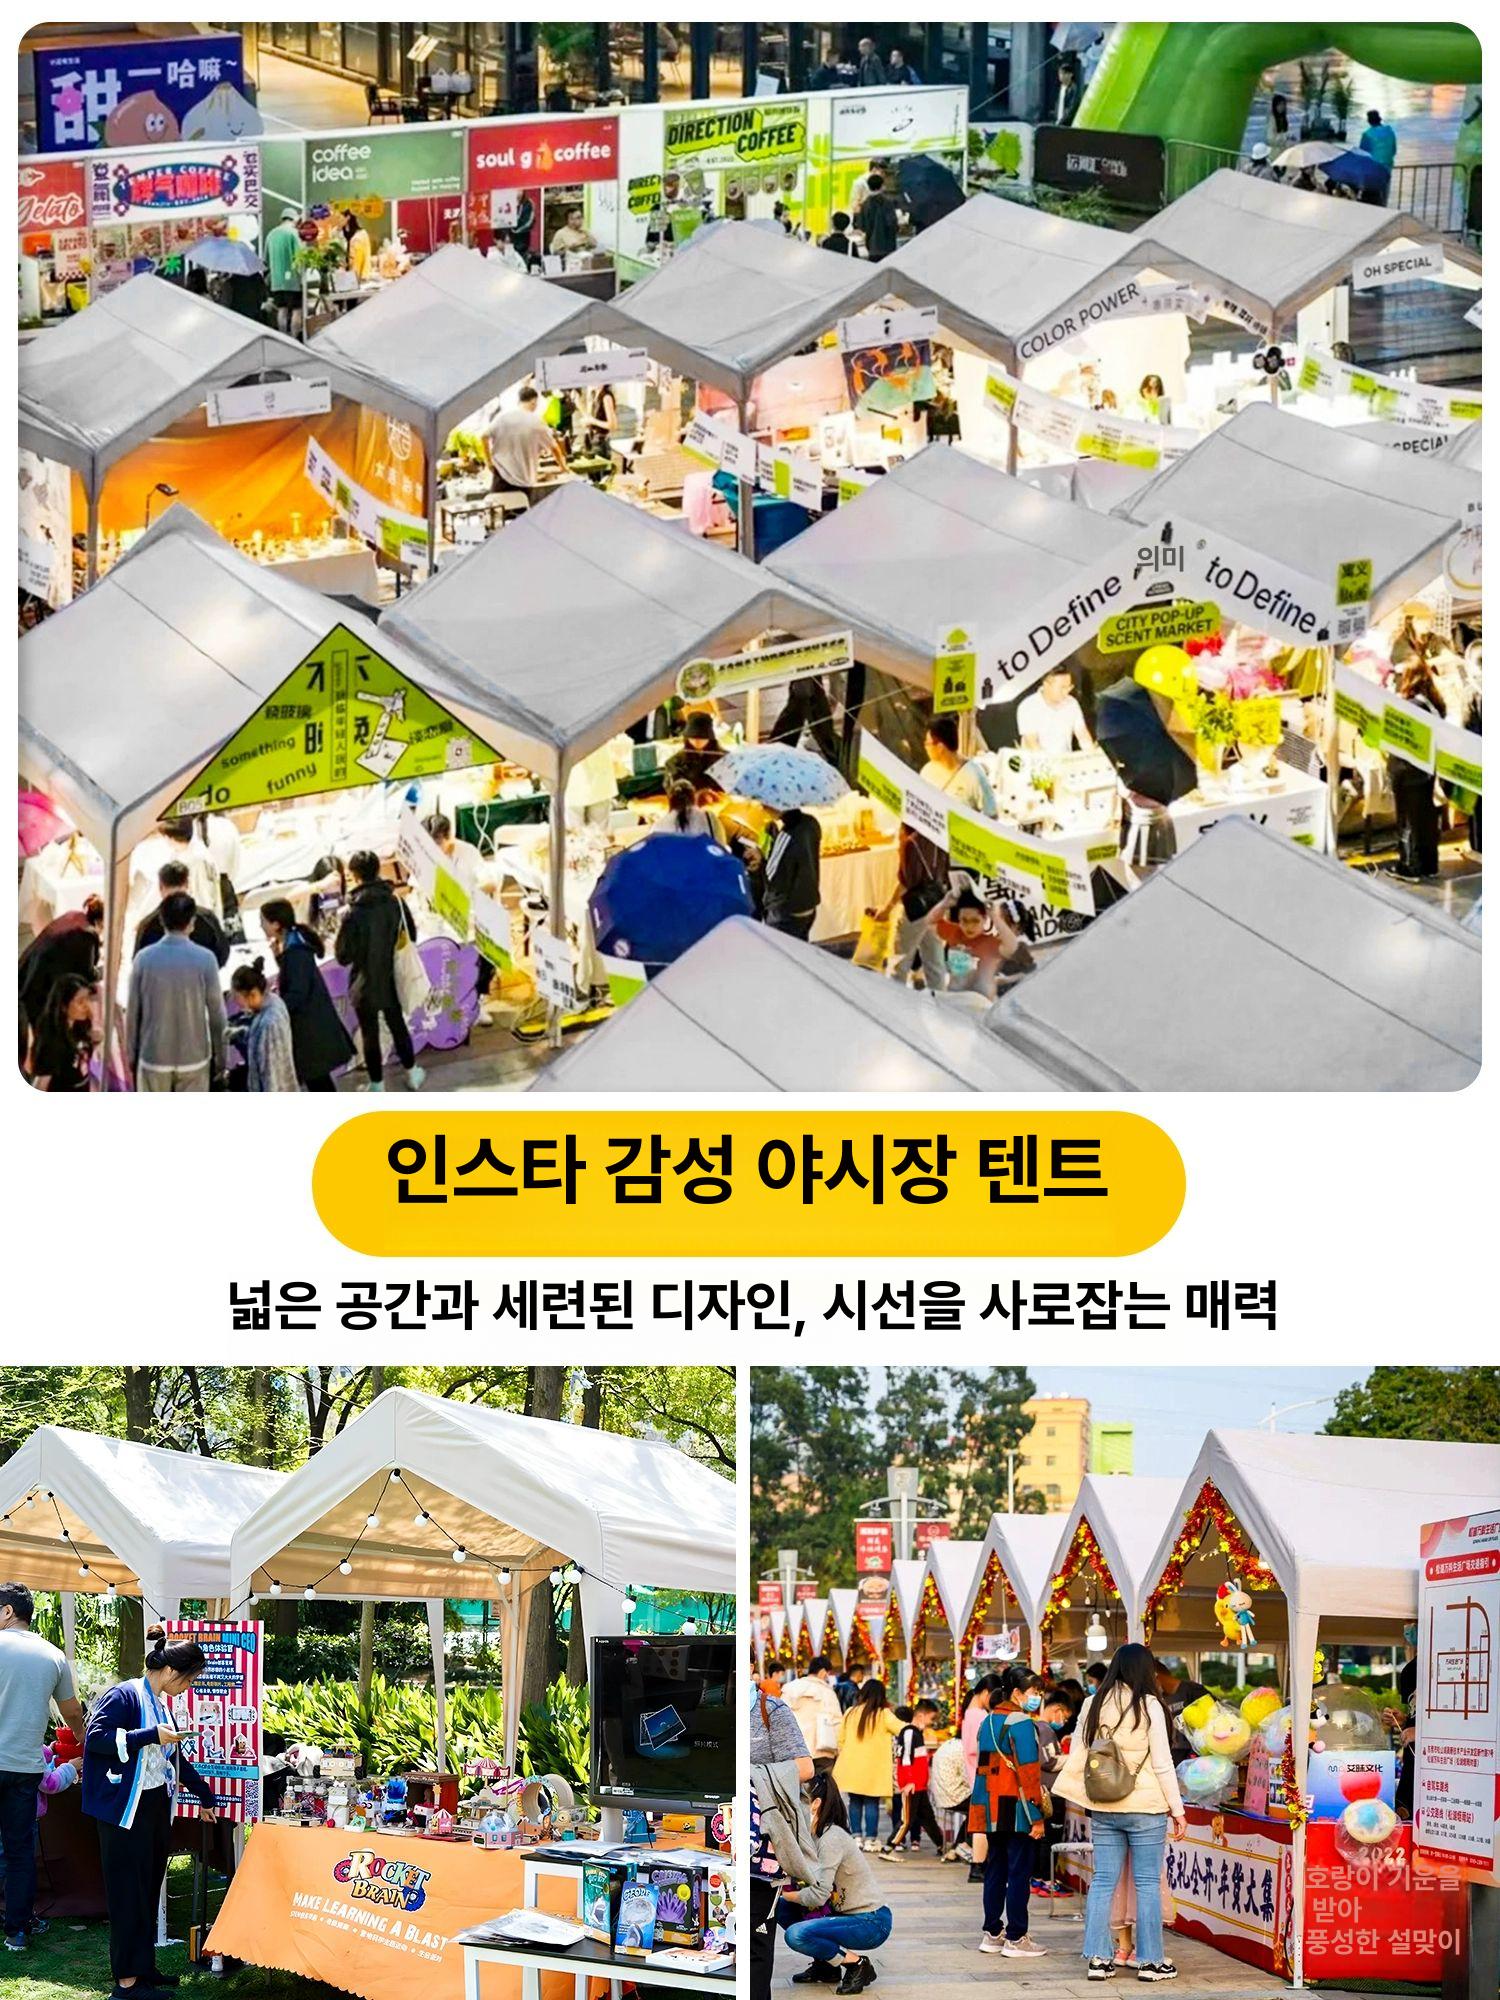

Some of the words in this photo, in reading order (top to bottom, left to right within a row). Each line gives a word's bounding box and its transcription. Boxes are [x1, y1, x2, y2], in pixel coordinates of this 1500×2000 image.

[668, 109, 755, 146] DIRECTION
[737, 124, 797, 154] COFFEE
[312, 143, 372, 164] coffee
[476, 149, 515, 169] soul
[553, 141, 612, 162] coffee
[180, 165, 231, 182] COFFEE
[312, 164, 353, 183] idea
[1364, 264, 1381, 278] OH
[1383, 256, 1433, 276] SPECIAL
[1020, 316, 1078, 360] COLOR
[1079, 282, 1141, 326] POWER
[1204, 556, 1234, 589] to
[1232, 569, 1316, 634] Define
[996, 649, 1030, 681] to
[1027, 574, 1123, 658] Define
[1106, 629, 1155, 647] SCENT
[1154, 619, 1214, 638] MARKET
[1115, 613, 1147, 631] CITY
[1150, 605, 1205, 625] POP-UP
[221, 735, 296, 769] something
[266, 762, 318, 795] funny
[197, 1632, 221, 1643] BRAIN
[221, 1632, 240, 1647] MINI
[241, 1632, 256, 1653] CEO
[348, 1850, 431, 1890] ROCKET
[351, 1878, 409, 1911] BRAIN
[292, 1891, 322, 1910] MAKE
[322, 1897, 389, 1933] LEARNING
[389, 1919, 403, 1937] A
[404, 1923, 449, 1951] BLAST
